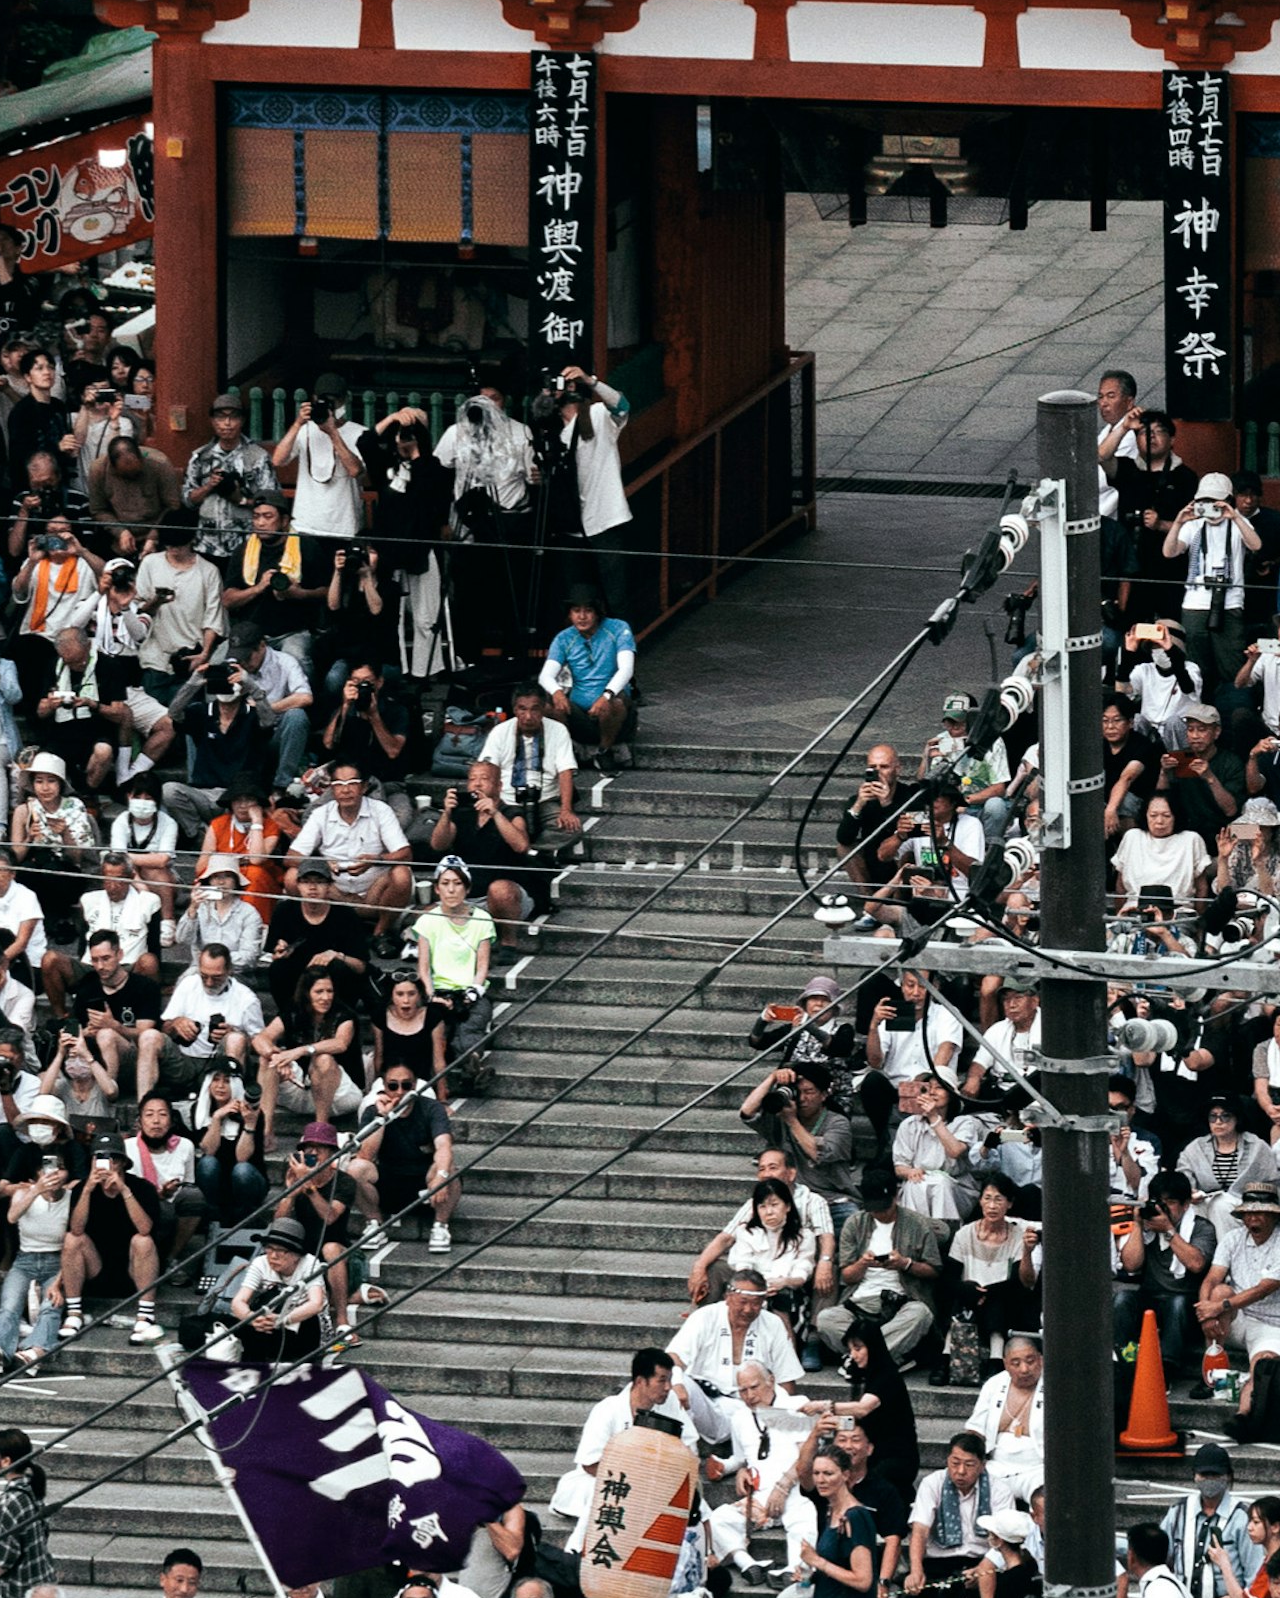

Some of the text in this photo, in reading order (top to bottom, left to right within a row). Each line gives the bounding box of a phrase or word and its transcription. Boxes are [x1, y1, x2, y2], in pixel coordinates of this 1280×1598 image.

[535, 54, 561, 148] 午後六時
[565, 53, 591, 157] 七月十七日
[1166, 74, 1195, 170] 午後四時
[1197, 72, 1224, 177] 七月十七日
[1171, 197, 1227, 379] 神幸祭
[588, 1470, 631, 1570] 神輿会
